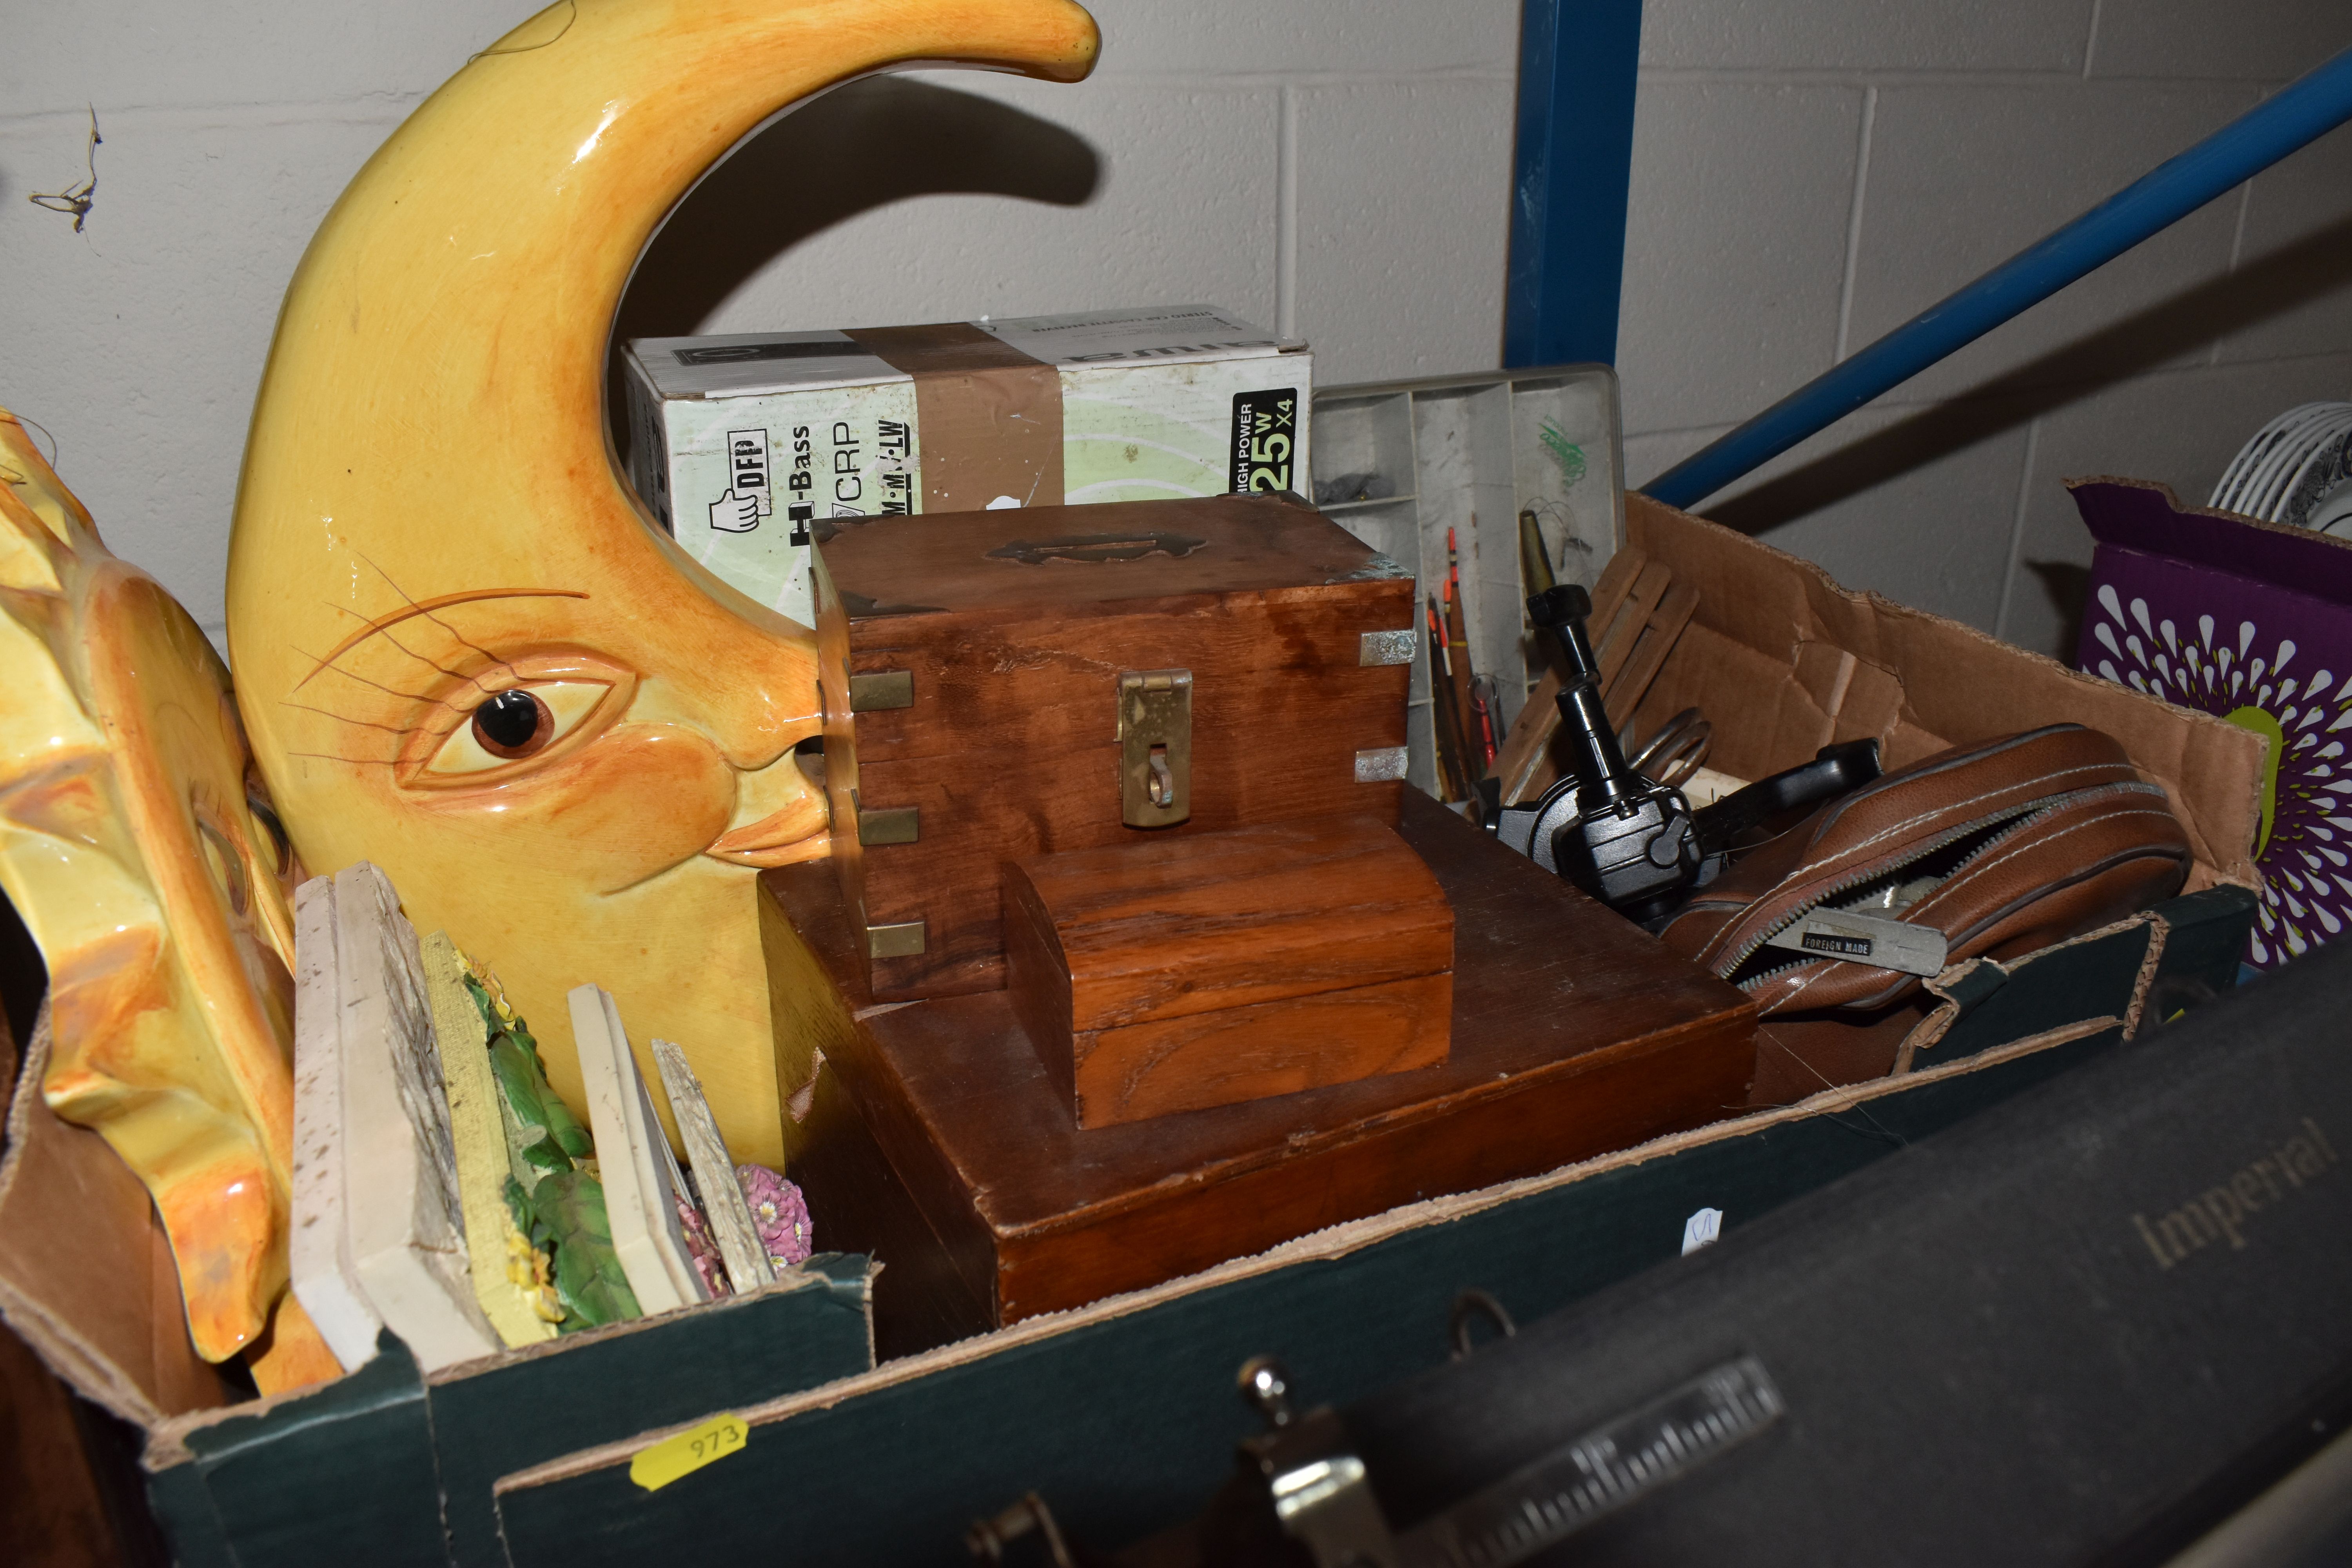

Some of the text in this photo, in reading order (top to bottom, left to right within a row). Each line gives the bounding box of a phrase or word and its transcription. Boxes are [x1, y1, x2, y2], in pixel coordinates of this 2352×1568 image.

[1239, 403, 1252, 458] POWER
[735, 440, 766, 488] DFP
[788, 426, 815, 547] H-Bass
[833, 422, 862, 501] CRP
[1806, 938, 1869, 954] FOREIGN MADE
[2130, 1116, 2339, 1272] Imperial
[690, 1425, 740, 1459] 973
